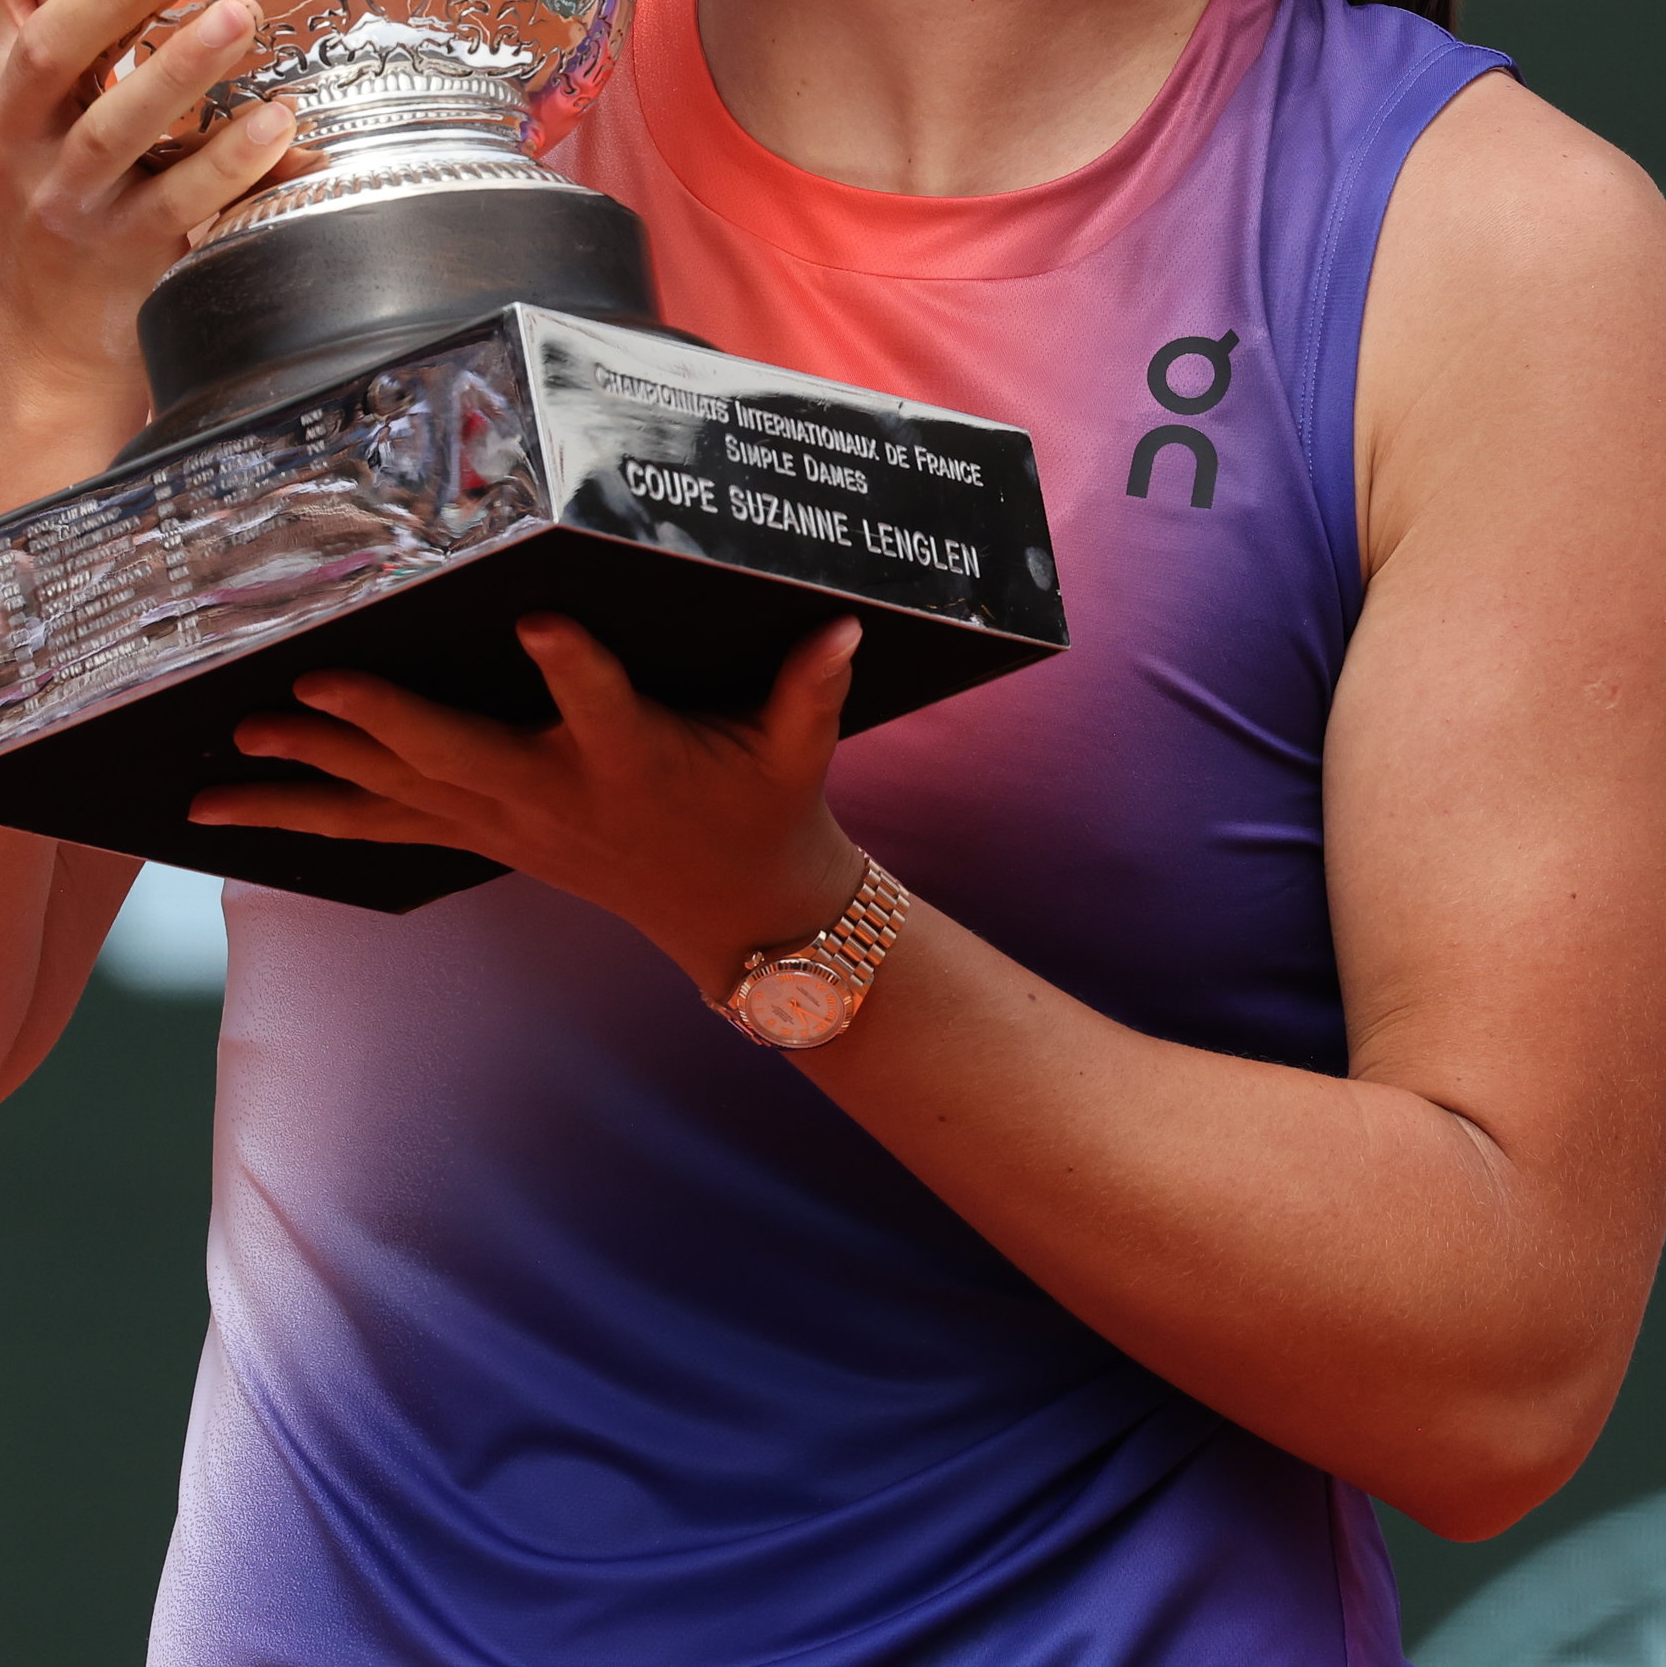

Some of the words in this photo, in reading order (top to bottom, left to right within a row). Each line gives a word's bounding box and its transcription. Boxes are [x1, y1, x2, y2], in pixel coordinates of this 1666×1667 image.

[725, 433, 796, 477] SIMPLE
[803, 452, 868, 494] DAMES
[735, 400, 880, 461] INTERNATIONAUX
[914, 444, 984, 487] FRANCE
[626, 459, 719, 514] COUPE
[728, 484, 852, 547] SUZANNE
[862, 518, 980, 579] LENGLEN
